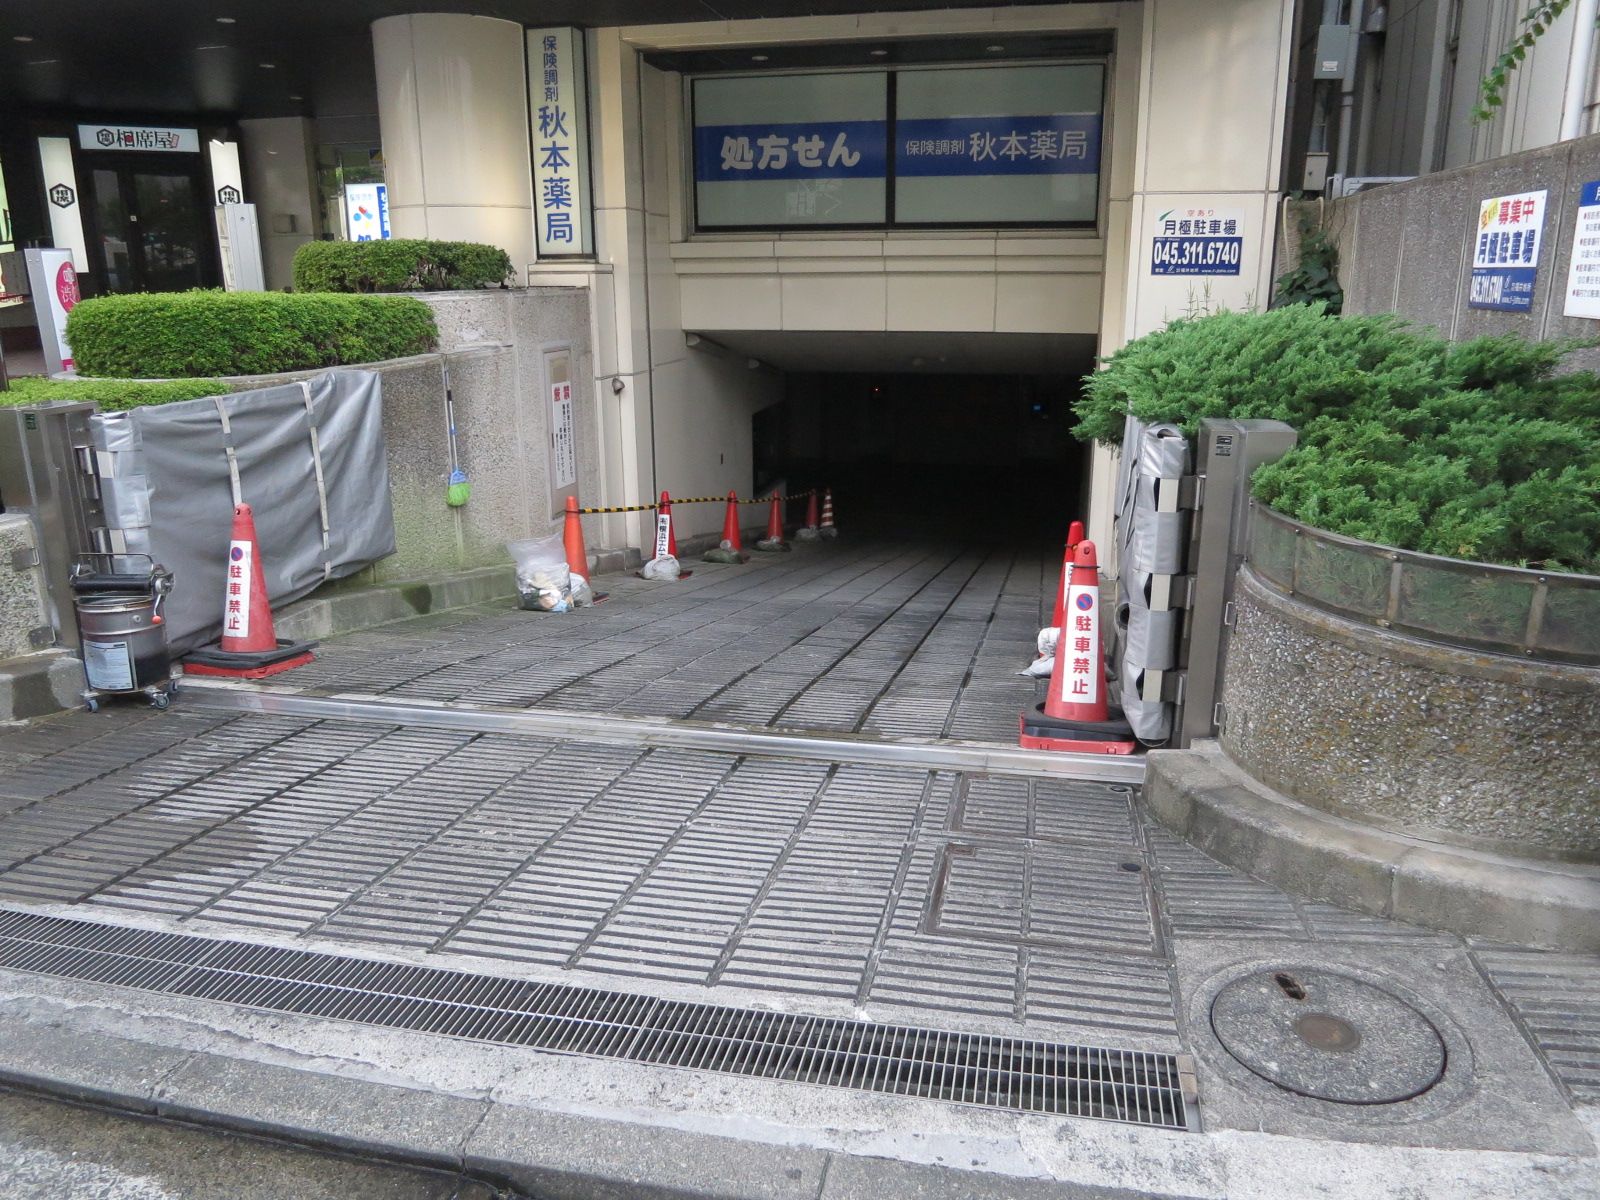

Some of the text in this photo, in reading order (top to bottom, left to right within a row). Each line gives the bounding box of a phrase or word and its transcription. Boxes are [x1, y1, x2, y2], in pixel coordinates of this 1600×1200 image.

[116, 127, 171, 149] 相席屋
[538, 35, 573, 244] 保険調剤 秋本薬局
[720, 131, 861, 171] 処方せん
[905, 130, 1088, 163] 保険調剤 秋本薬局
[1163, 219, 1237, 236] 月極駐車場
[1498, 197, 1535, 226] 募集中
[1153, 241, 1239, 265] 045.311.6740
[1478, 229, 1536, 265] 月極駐車場
[228, 565, 242, 631] 駐車禁止
[1071, 615, 1092, 696] 駐車禁止
